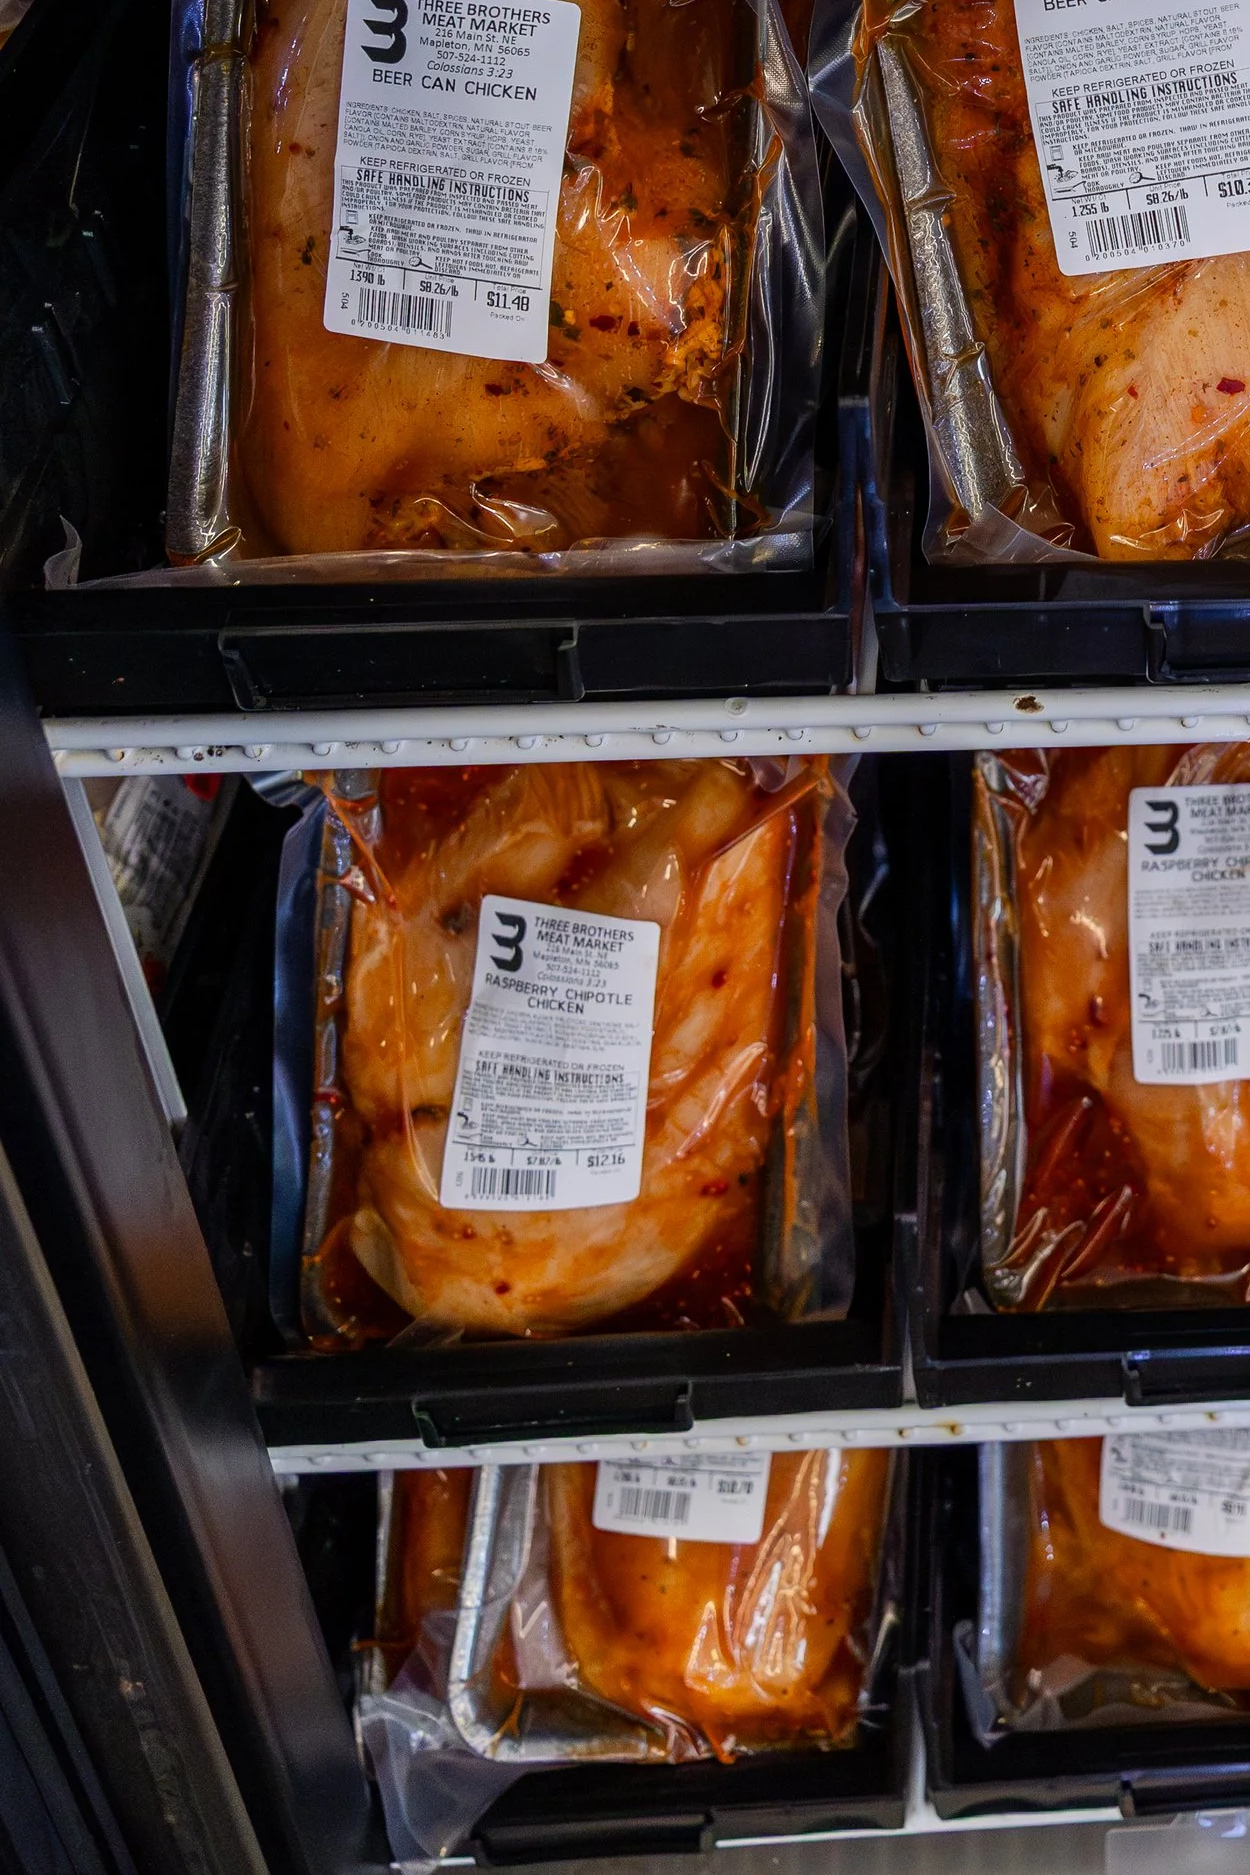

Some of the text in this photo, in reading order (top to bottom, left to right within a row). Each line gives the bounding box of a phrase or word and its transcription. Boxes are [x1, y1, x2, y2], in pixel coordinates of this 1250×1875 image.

[422, 11, 538, 37] MEAT MARKET
[466, 3, 551, 24] BROTHERS
[419, 36, 530, 57] Mapleton, MN 56065
[435, 27, 517, 45] 216 Main St. NE
[426, 59, 513, 79] Colossians 3:23
[436, 49, 506, 66] 507-524-1112
[372, 68, 537, 101] BEER CAN CHICKEN
[1051, 58, 1234, 98] KEEP REFRIGERATED OR FROZEN
[1051, 71, 1237, 114] SAFE HANDLING INSTRUCTIONS
[359, 156, 531, 187] KEEP REFRIGERATED OR FROZEN
[356, 168, 530, 203] SAFE HANDLING INSTRUCTIONS
[1071, 202, 1098, 218] 1.255
[1099, 201, 1109, 213] lb
[1145, 188, 1189, 206] $8.26/lb
[1068, 230, 1078, 249] 504
[376, 273, 385, 286] lb
[419, 279, 459, 297] $8.26/lb
[486, 290, 530, 312] $11.48
[1192, 867, 1246, 882] CHICKEN
[534, 916, 634, 941] THREE BROTHERS
[536, 930, 623, 952] MEAT MARKET
[485, 972, 632, 1005] RASPBERRY CHIPOTLE
[527, 996, 584, 1014] CHICKEN
